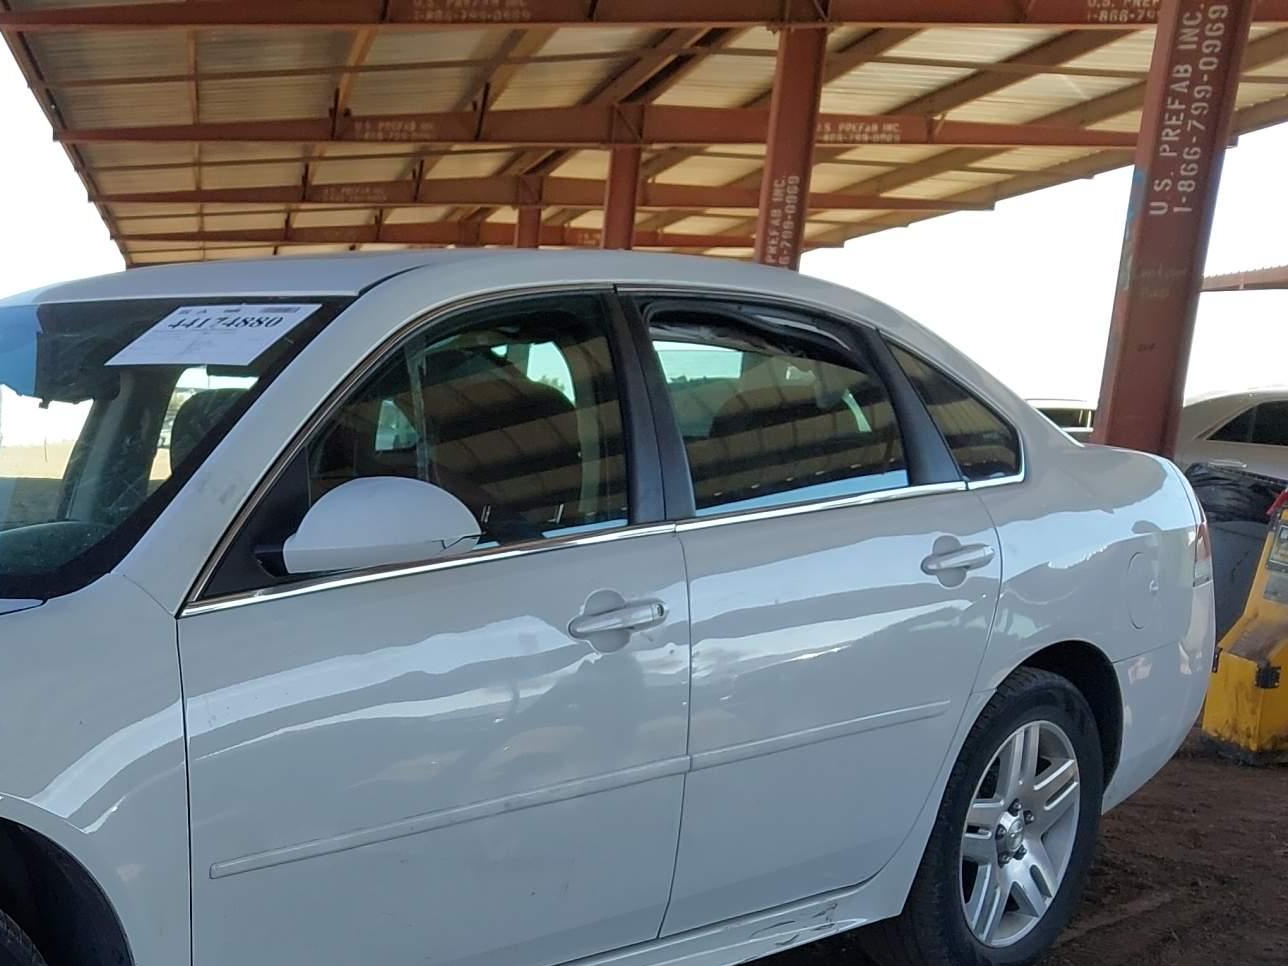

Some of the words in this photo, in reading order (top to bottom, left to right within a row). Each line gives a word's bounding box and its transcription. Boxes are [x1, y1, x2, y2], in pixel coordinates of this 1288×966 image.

[1159, 63, 1192, 157] PREFAB
[1178, 3, 1204, 50] INC.
[1172, 4, 1229, 214] 1-866-799-0969
[765, 208, 782, 264] PREFAB
[168, 316, 284, 329] 44174880
